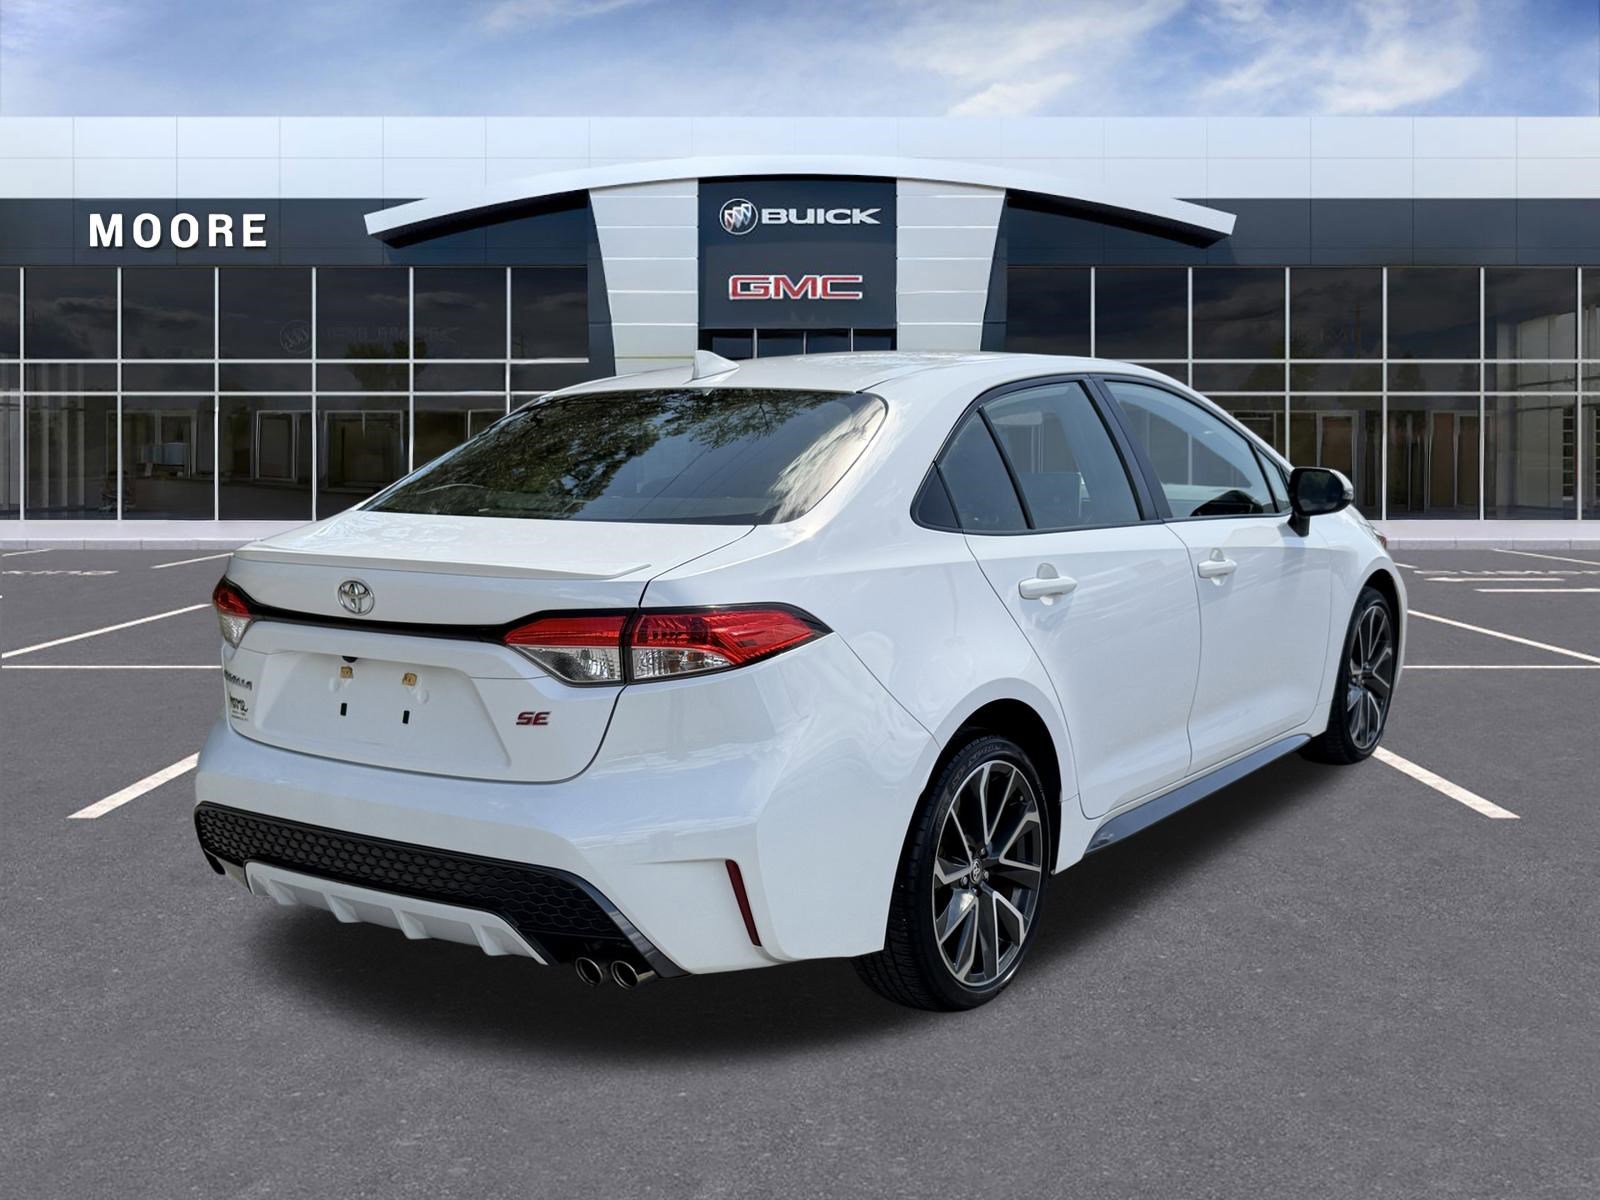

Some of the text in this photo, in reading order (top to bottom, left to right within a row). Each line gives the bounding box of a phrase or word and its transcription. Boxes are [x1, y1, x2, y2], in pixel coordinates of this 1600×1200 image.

[761, 208, 881, 224] BUICK
[89, 212, 267, 248] MOORE
[728, 274, 863, 300] GMC
[515, 711, 551, 726] SE
